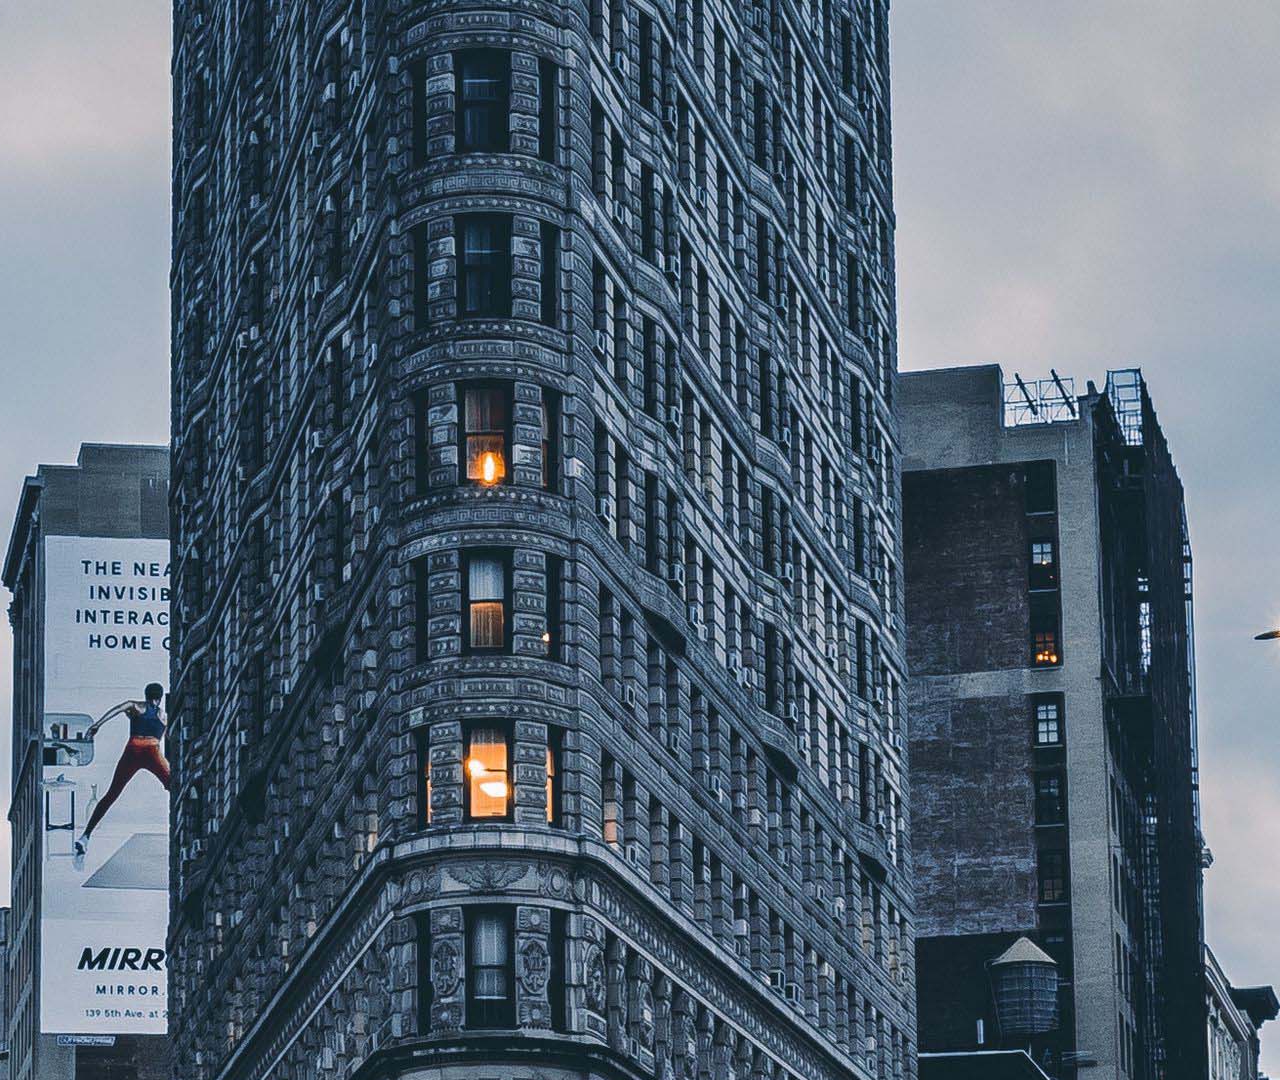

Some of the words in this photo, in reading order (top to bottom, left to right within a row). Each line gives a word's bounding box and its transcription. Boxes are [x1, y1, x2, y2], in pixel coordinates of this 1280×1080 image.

[81, 560, 122, 576] THE
[75, 608, 169, 626] INTERAC
[88, 634, 151, 650] HOME
[85, 1009, 101, 1018] 139
